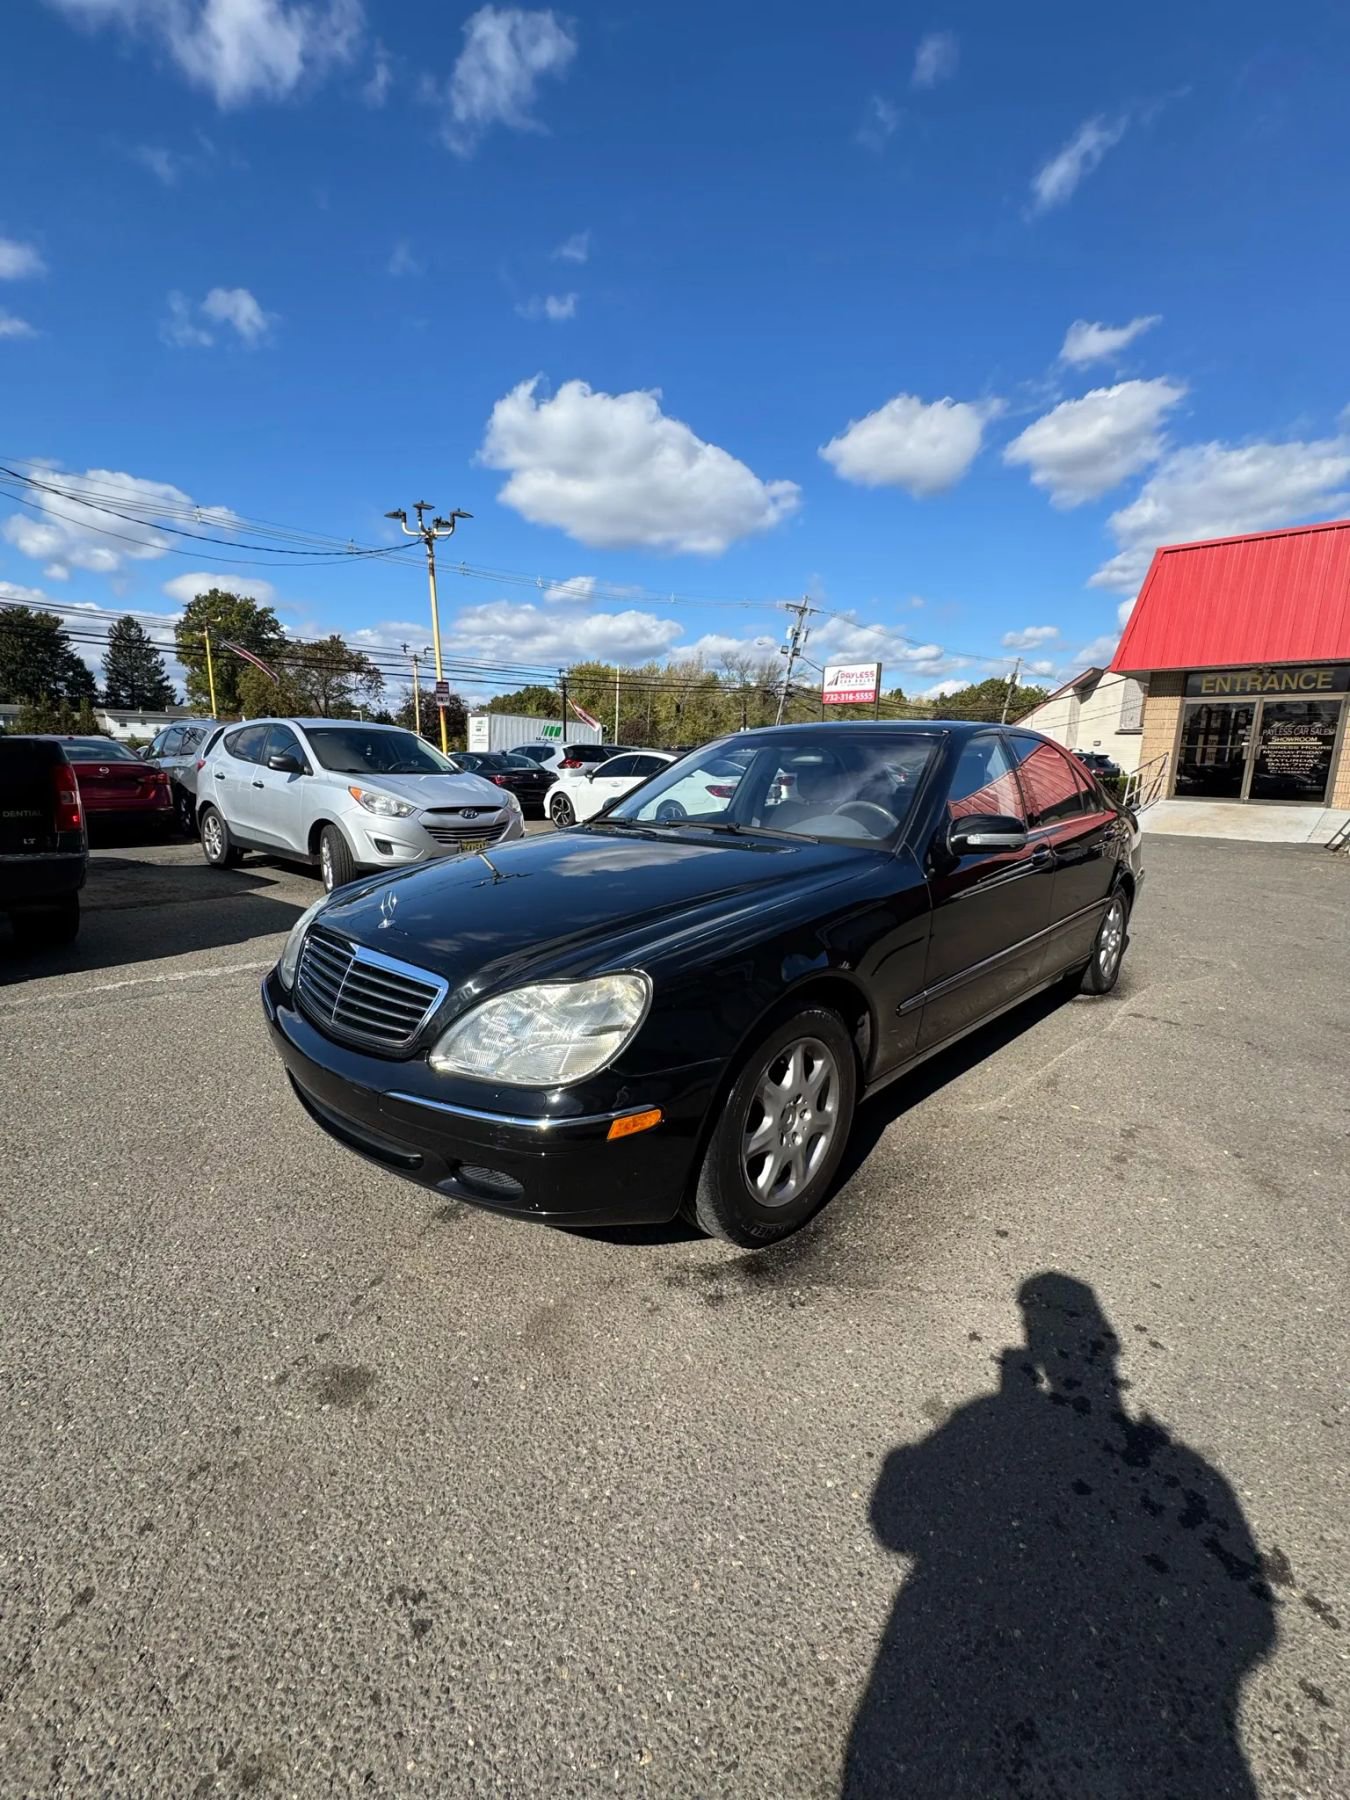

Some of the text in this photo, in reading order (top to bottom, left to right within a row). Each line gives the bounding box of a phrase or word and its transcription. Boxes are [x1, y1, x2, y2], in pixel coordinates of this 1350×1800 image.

[840, 670, 875, 679] PAYLESS
[1201, 671, 1334, 694] ENTRANCE
[1262, 728, 1293, 736] PAYLESS
[1294, 727, 1309, 736] CAR
